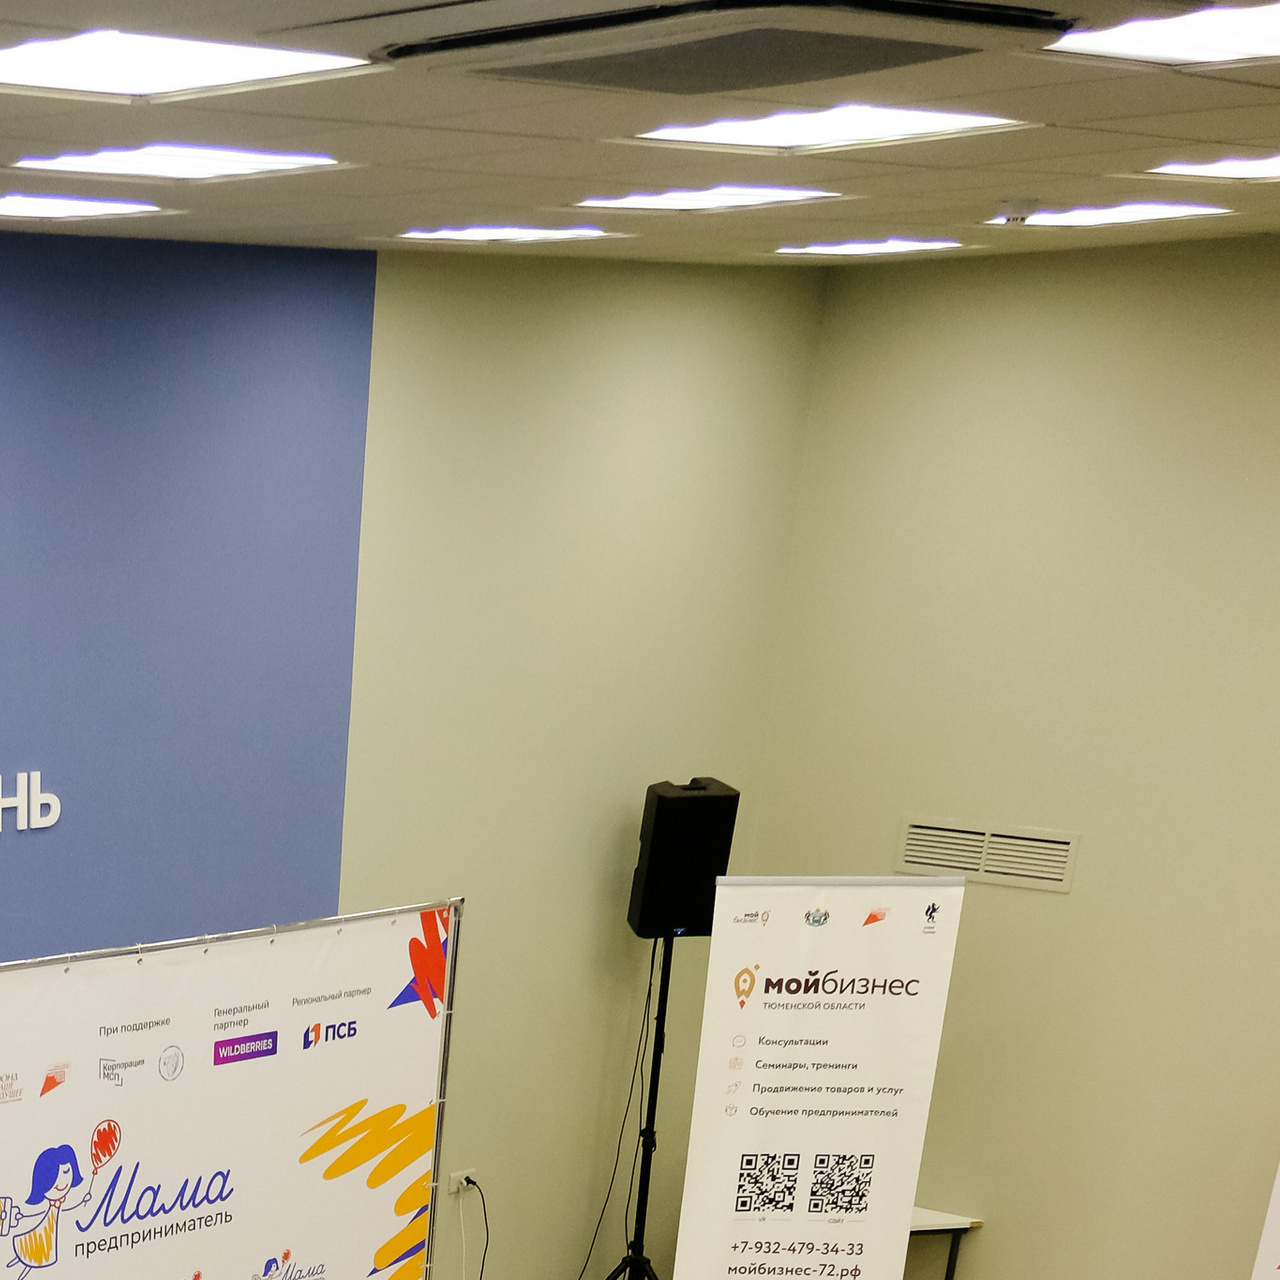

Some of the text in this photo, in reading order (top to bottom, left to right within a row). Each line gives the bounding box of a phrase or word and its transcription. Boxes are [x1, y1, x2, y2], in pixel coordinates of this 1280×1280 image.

[292, 986, 372, 1007] Региональный партнер
[214, 1000, 270, 1018] Генеральный
[763, 1001, 866, 1010] ТЮМЕНСКОЙ ОБЛАСТИ
[99, 1016, 171, 1037] При поддержке
[214, 1017, 249, 1032] партнер
[325, 1020, 358, 1043] ПСБ
[218, 1038, 273, 1059] WILDBERRIES
[758, 1036, 829, 1048] Консультации
[103, 1057, 146, 1072] Корпорация
[755, 1060, 858, 1071] Семинары, тренинги
[102, 1071, 120, 1082] МСП
[752, 1083, 823, 1094] Продвижение
[825, 1086, 865, 1095] товаров
[876, 1087, 904, 1096] услуг
[749, 1107, 898, 1118] Обучение предпринимателей
[75, 1162, 234, 1232] Мама
[74, 1209, 234, 1259] предприниматель
[731, 1241, 864, 1256] +7-932-479-34-33
[727, 1263, 862, 1280] мойбизнес-72.рф
